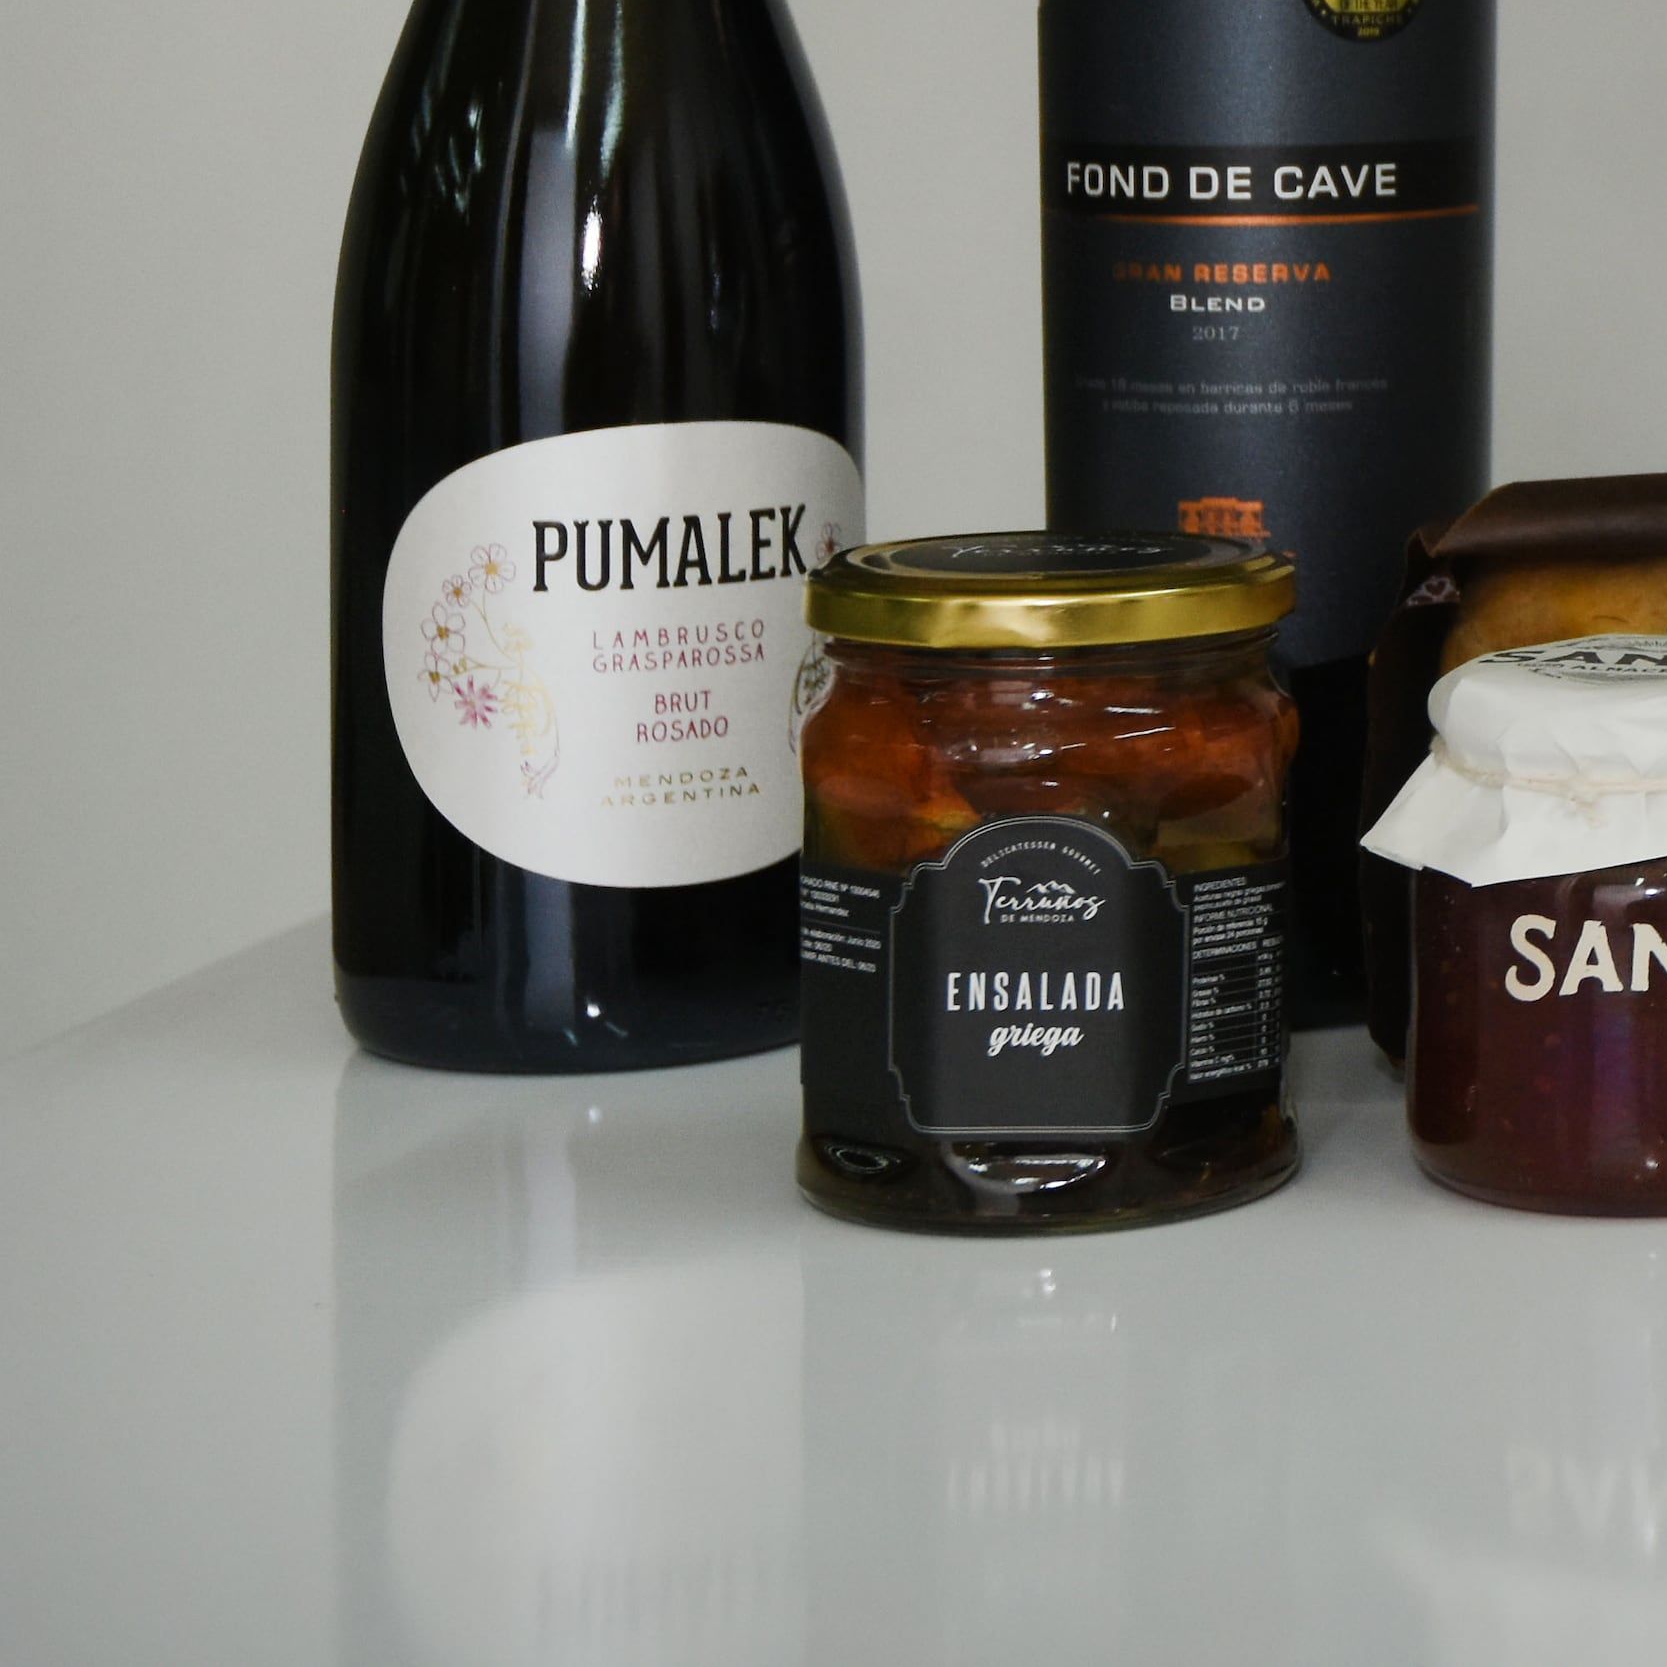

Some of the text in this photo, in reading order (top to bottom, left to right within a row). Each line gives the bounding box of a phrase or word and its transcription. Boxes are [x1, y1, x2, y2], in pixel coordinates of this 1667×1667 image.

[1067, 161, 1397, 201] FOND DE CAVE
[1112, 262, 1333, 285] GRAN RESERVA
[1191, 325, 1240, 342] 2017
[532, 504, 807, 593] PUMALEK
[592, 621, 766, 650] LAMBRUSCO
[592, 644, 766, 674] GRASPAROSSA
[653, 690, 711, 715] BRUT
[635, 717, 730, 744] ROSADO
[612, 766, 750, 789] MENDOZA
[599, 782, 762, 807] ARGENTINA
[1000, 914, 1075, 924] DE MENDOZA
[946, 971, 1125, 1012] ENSALADA
[987, 1022, 1085, 1058] griega
